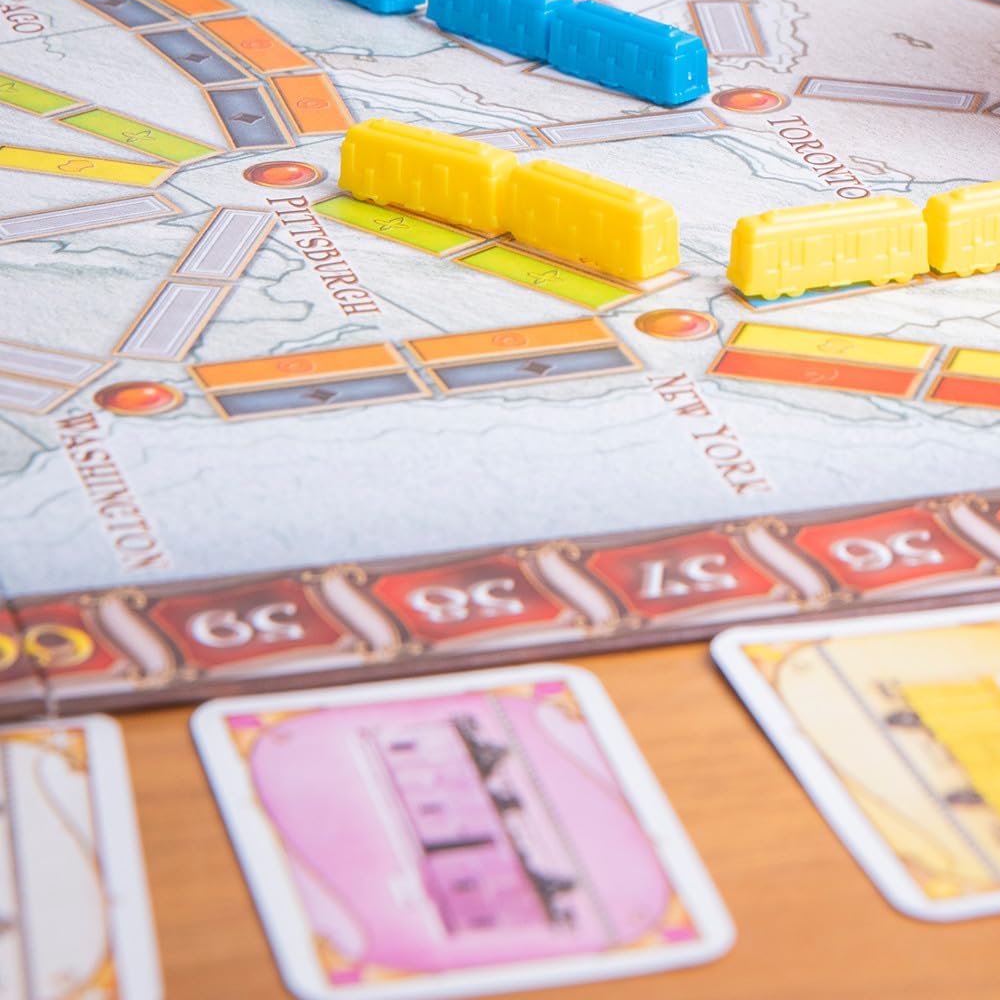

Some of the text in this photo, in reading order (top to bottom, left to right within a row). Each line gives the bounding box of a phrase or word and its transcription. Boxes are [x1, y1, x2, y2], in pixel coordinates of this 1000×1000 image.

[766, 114, 872, 199] TORONTO
[266, 195, 381, 318] PITTSBURGH
[645, 371, 774, 494] NEW YORK
[54, 408, 172, 572] WASHINGTON
[640, 553, 739, 599] 57
[830, 529, 945, 572] 56
[189, 602, 304, 649] 59
[405, 578, 525, 625] 58
